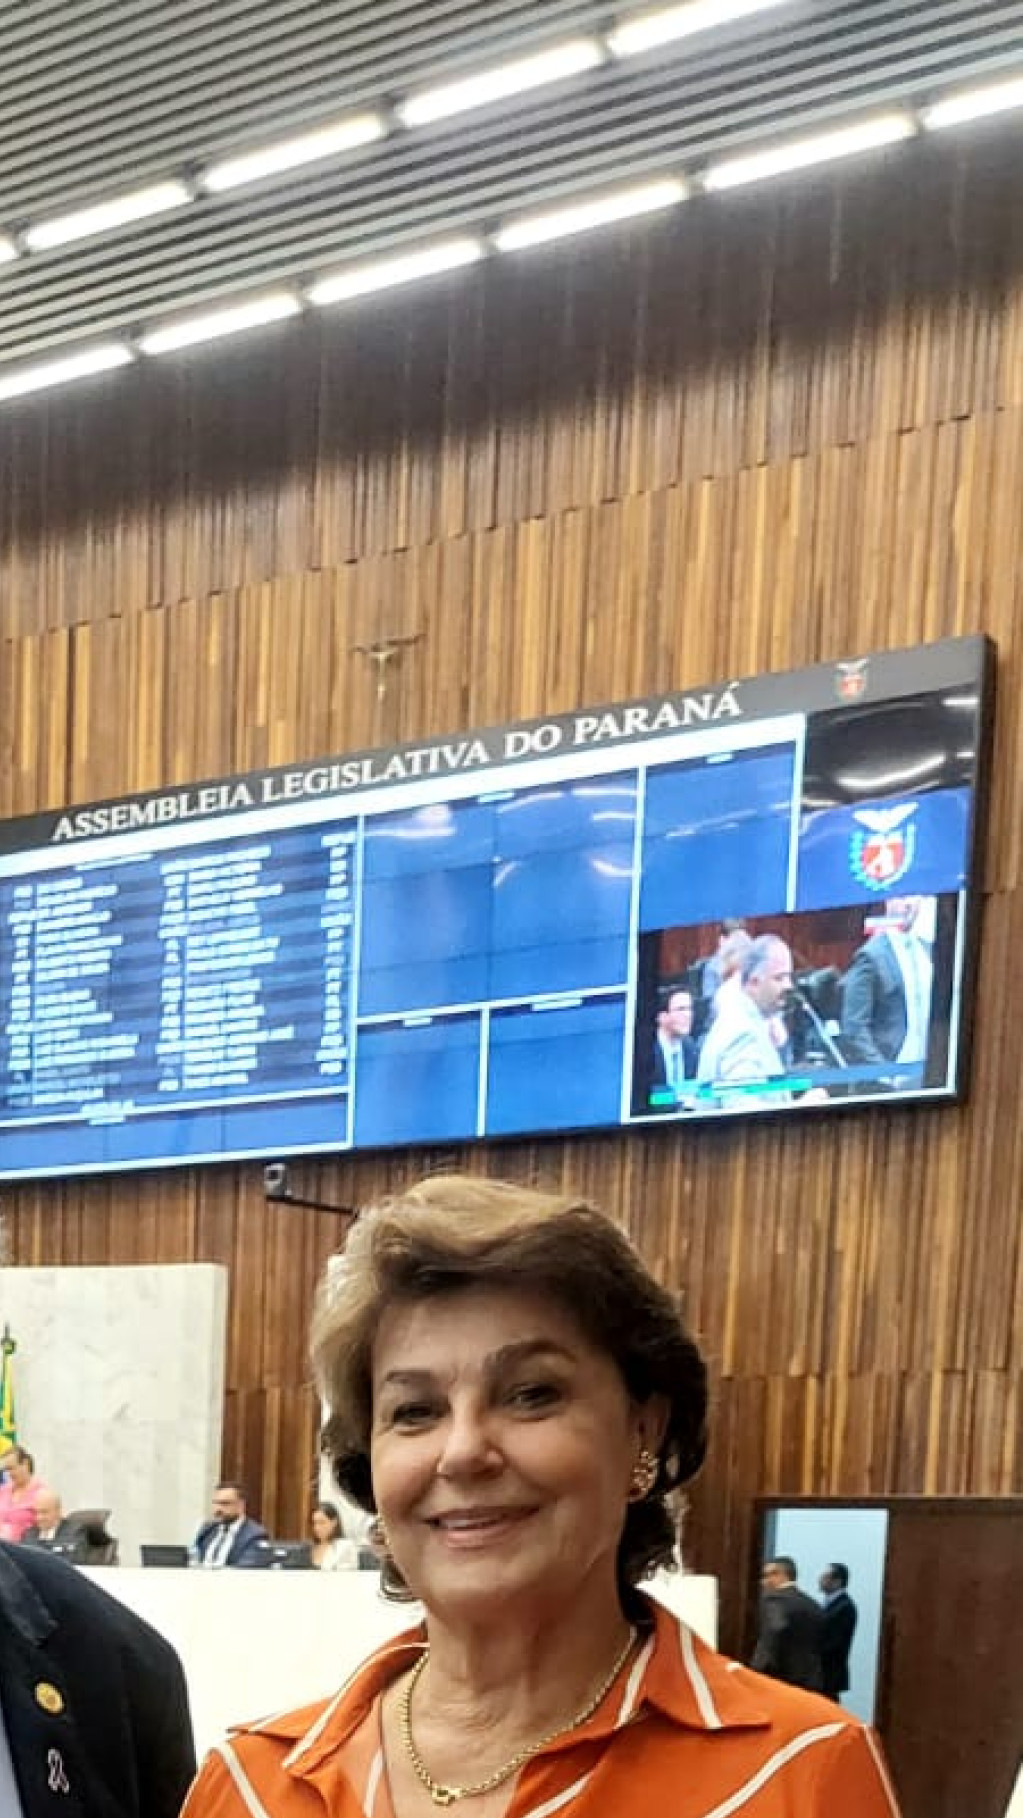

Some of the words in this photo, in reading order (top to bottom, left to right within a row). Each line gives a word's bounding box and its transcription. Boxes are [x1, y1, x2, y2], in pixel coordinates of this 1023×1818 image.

[51, 783, 254, 841] ASSEMBLEIA
[261, 741, 490, 802] LEGISLATIVA
[503, 724, 562, 758] DO
[572, 680, 743, 746] PARANÁ
